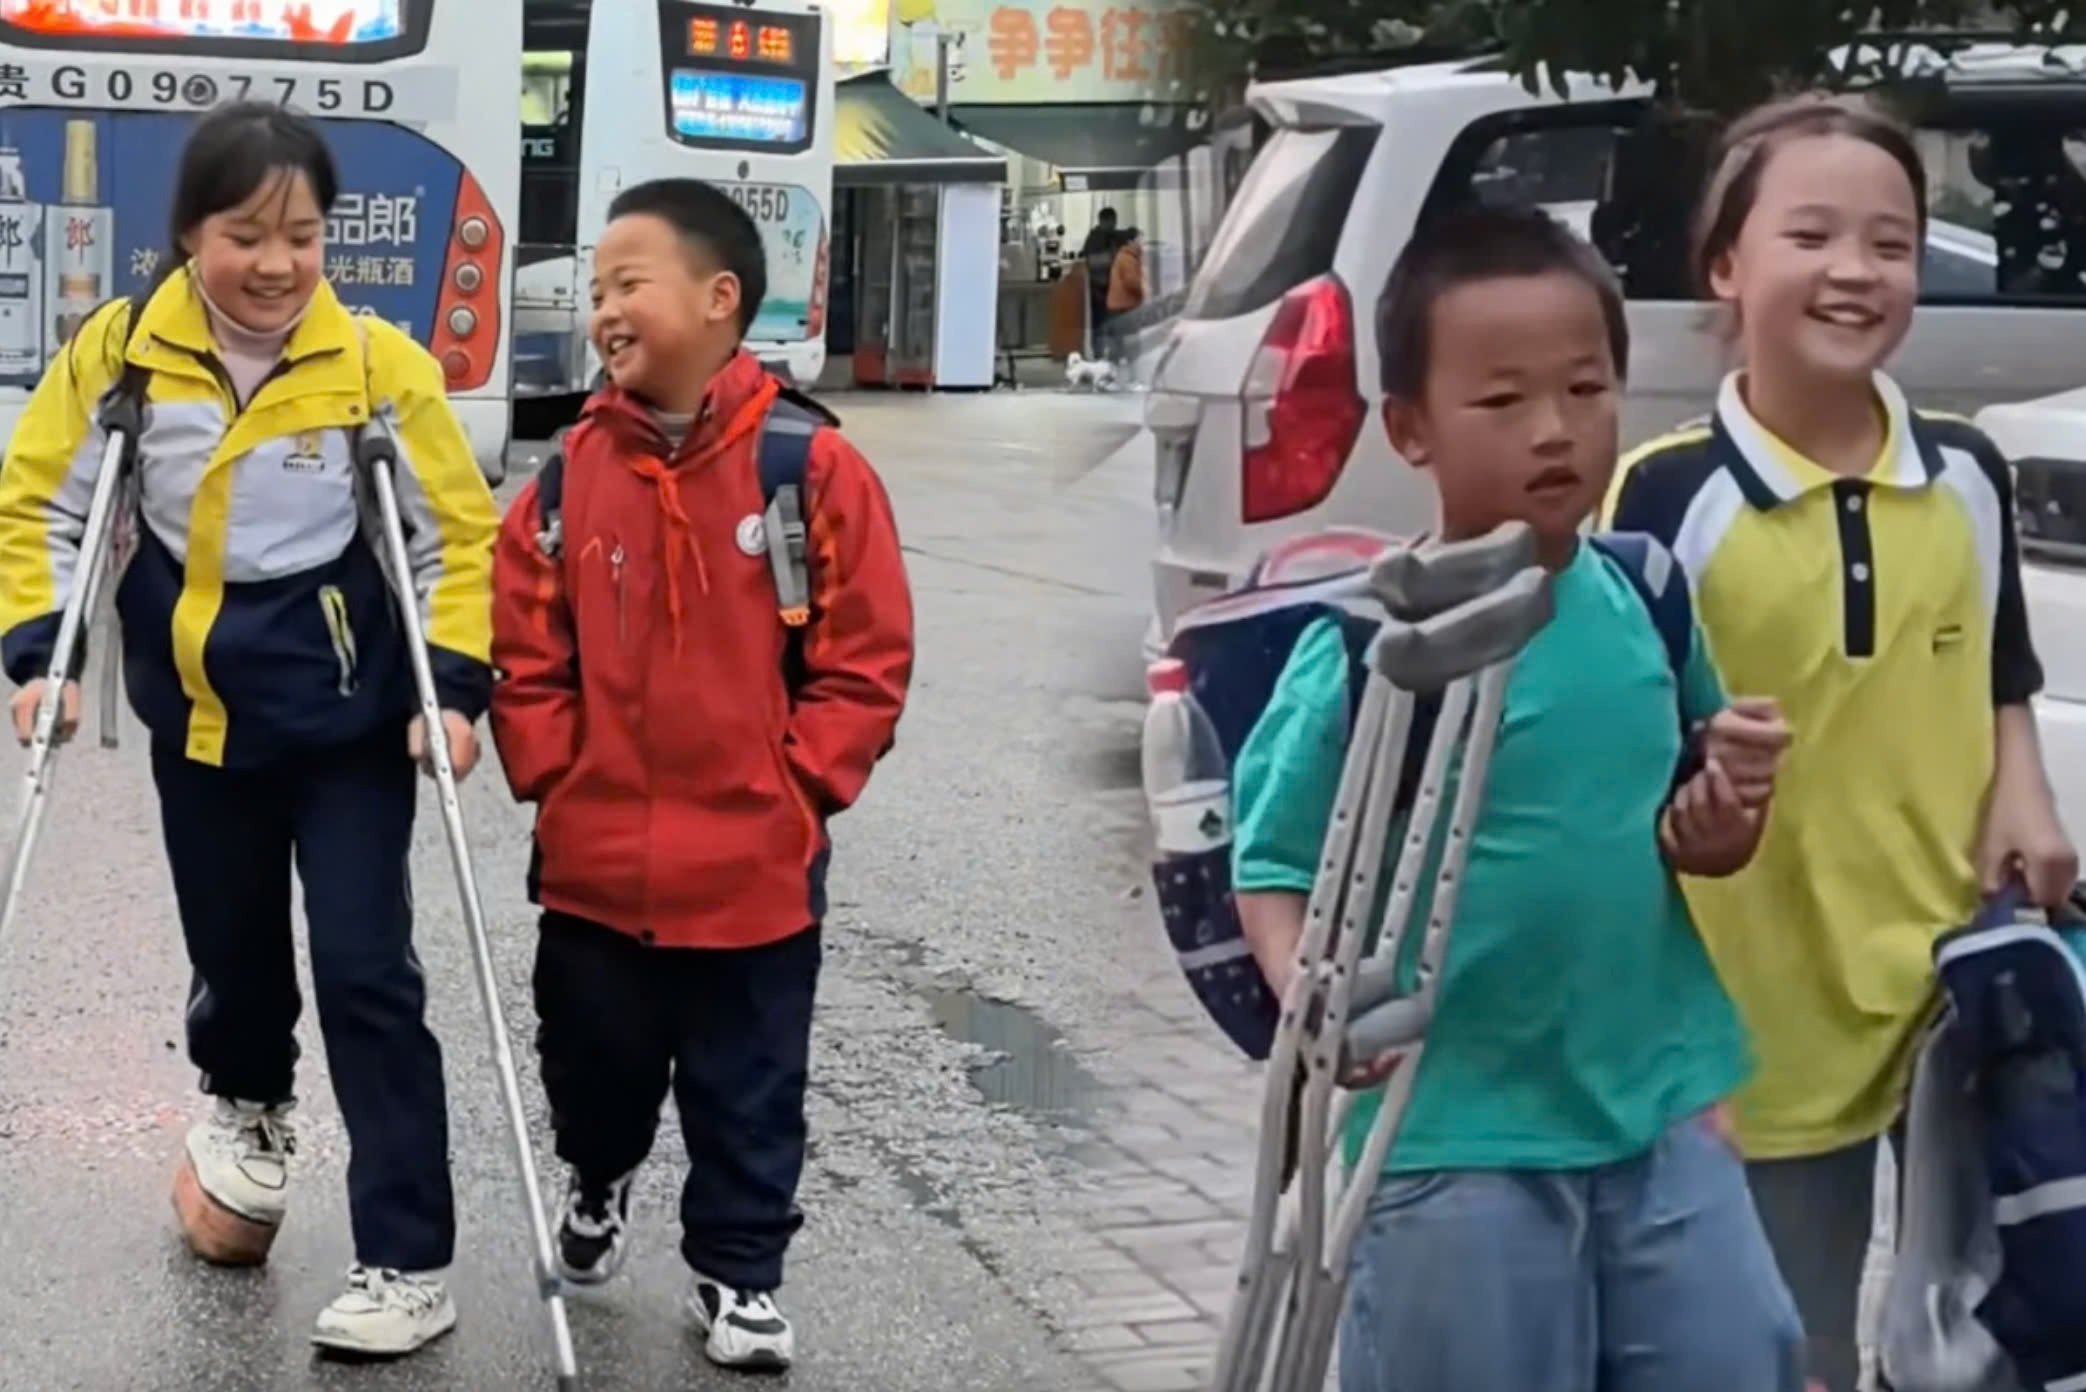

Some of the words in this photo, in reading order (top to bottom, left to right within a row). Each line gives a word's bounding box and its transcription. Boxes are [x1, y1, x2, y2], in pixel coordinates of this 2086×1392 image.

[720, 186, 790, 222] 055D
[327, 254, 414, 285] 光瓶酒
